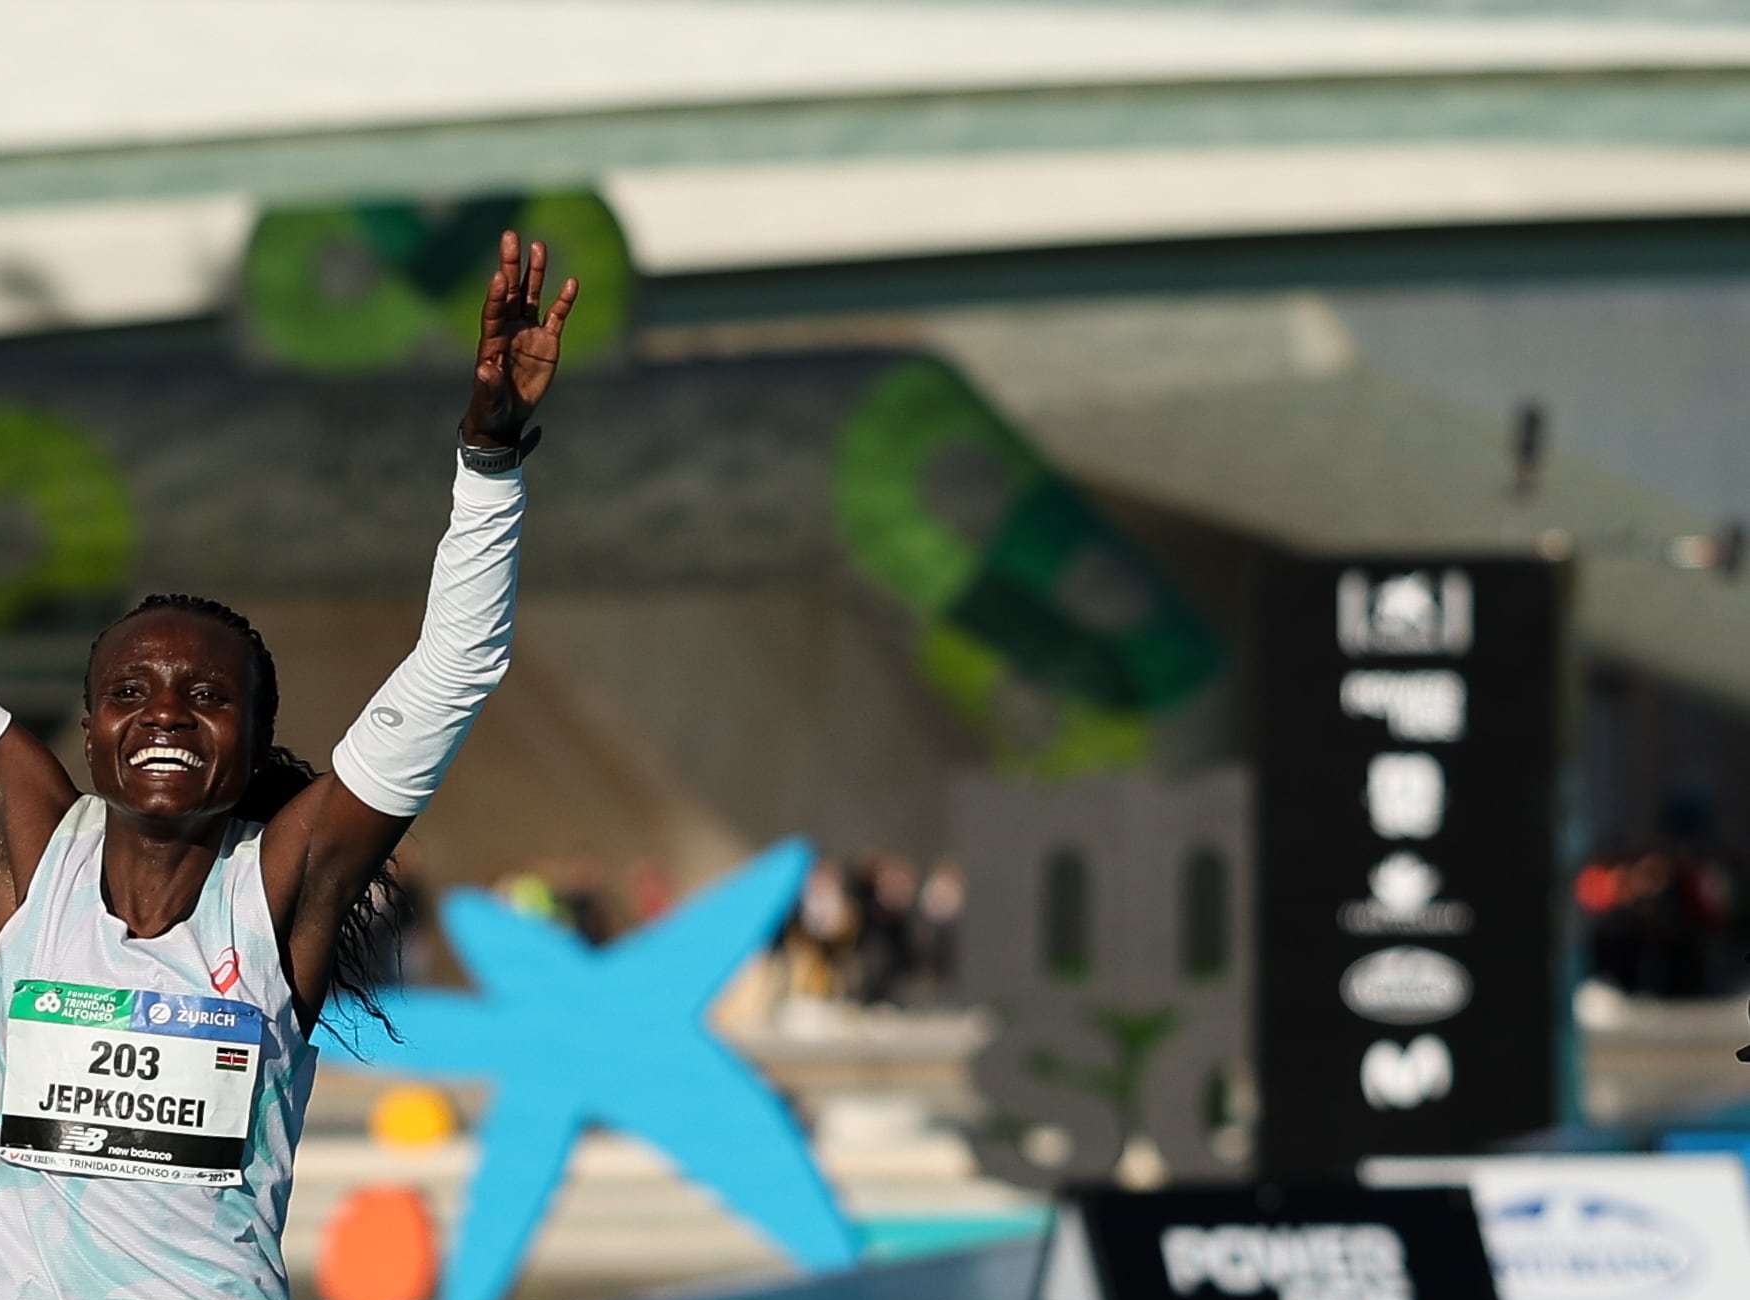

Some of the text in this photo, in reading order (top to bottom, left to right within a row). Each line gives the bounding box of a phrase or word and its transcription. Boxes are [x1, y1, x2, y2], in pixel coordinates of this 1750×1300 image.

[61, 1008, 113, 1022] ALFONSO
[63, 998, 115, 1013] TRINIDAD
[177, 1009, 236, 1028] ZURICH
[88, 1040, 161, 1081] 203
[38, 1083, 206, 1129] JEPKOSGEI
[108, 1146, 130, 1157] new
[130, 1147, 172, 1162] balance
[68, 1158, 118, 1173] TRINIDAD
[119, 1164, 169, 1178] ALFONSO
